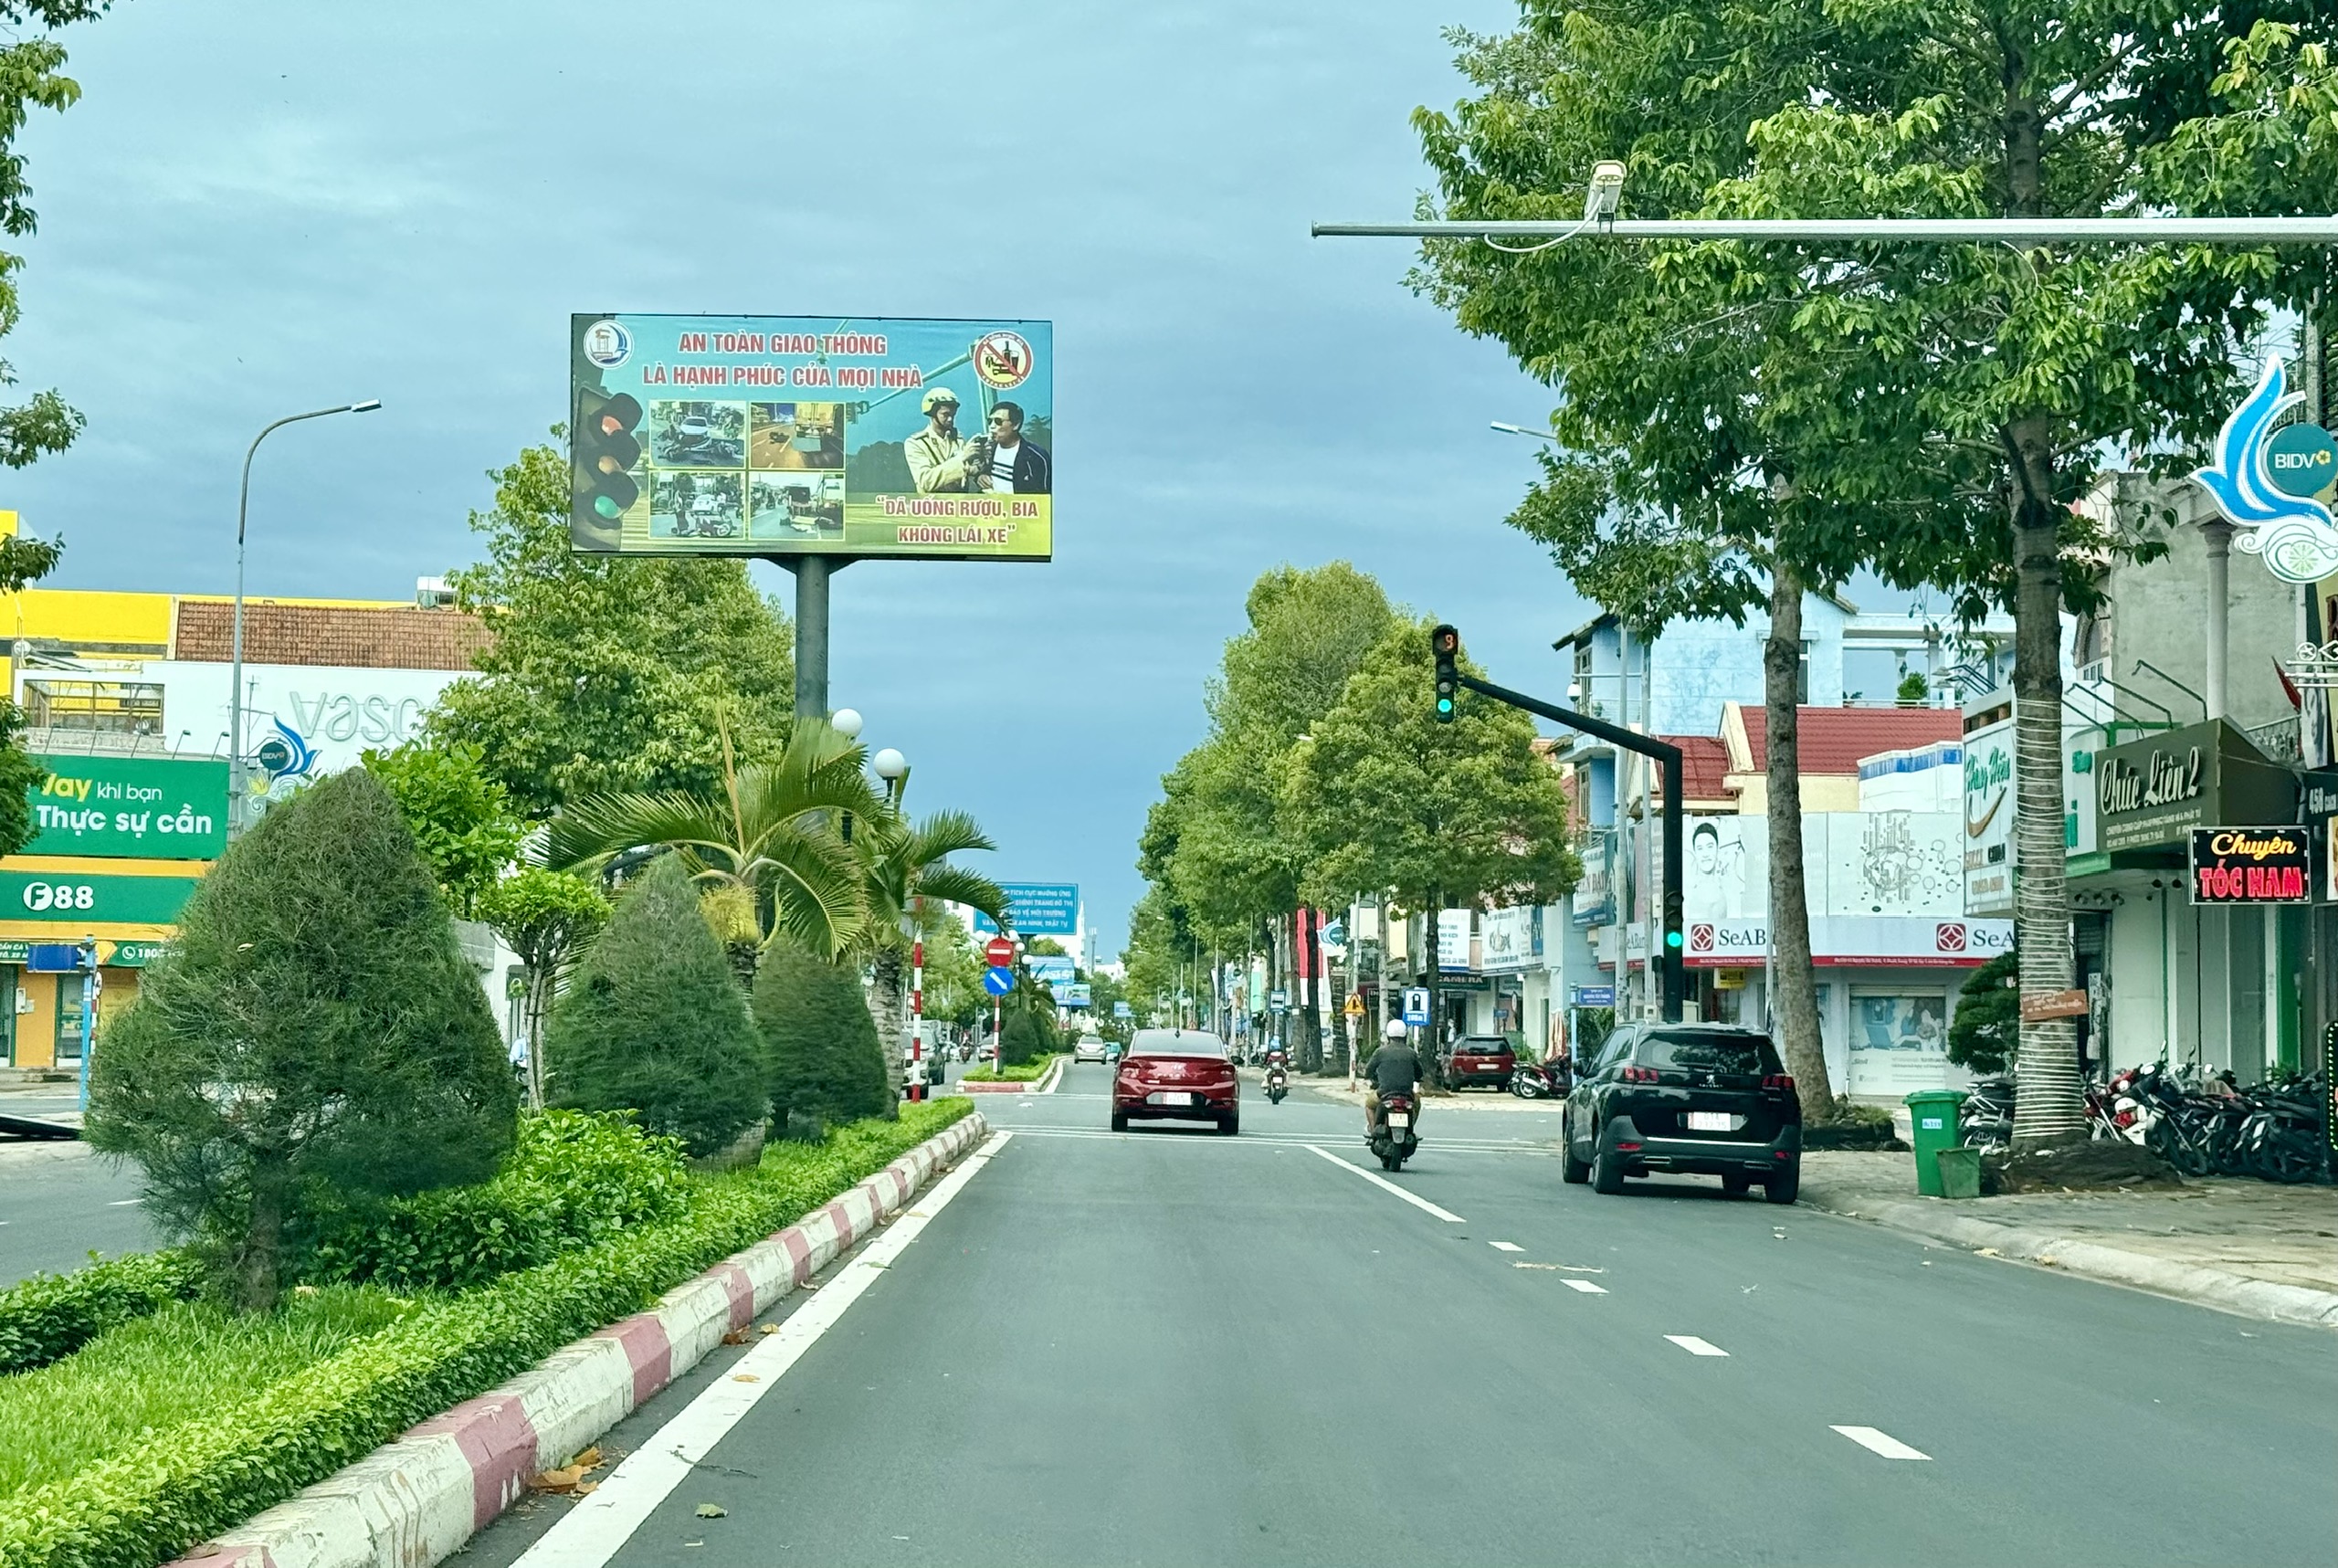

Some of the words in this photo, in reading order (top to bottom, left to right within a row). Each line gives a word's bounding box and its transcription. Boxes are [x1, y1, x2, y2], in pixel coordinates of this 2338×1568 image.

[679, 333, 707, 353] AN
[712, 330, 764, 353] TOÀN
[771, 334, 816, 353] GIAO
[822, 331, 886, 354] THÔNG
[643, 362, 667, 384] LÀ
[673, 365, 727, 389] HẠNH
[733, 363, 785, 385] PHÚC
[793, 362, 831, 386] CỦA
[837, 368, 875, 391] MỌI
[881, 363, 922, 387] NHÀ
[2275, 453, 2317, 468] BIDV
[911, 495, 954, 516] UỐNG
[960, 500, 1006, 520] RƯỢU,
[1012, 501, 1038, 517] BIA
[899, 524, 953, 542] KHÔNG
[958, 523, 982, 542] LÁI
[2143, 749, 2185, 807] Liên
[2186, 746, 2200, 797] 2
[97, 782, 121, 800] khi
[126, 784, 163, 804] bạn
[37, 805, 107, 837] Thực
[115, 811, 151, 838] sự
[156, 803, 212, 835] cần
[2211, 833, 2297, 861] Chuyên
[2199, 858, 2243, 898] TÓC
[2247, 867, 2303, 898] NAM
[24, 882, 94, 911] F88
[1718, 929, 1767, 946] SeAB
[1973, 930, 2016, 948] SeA
